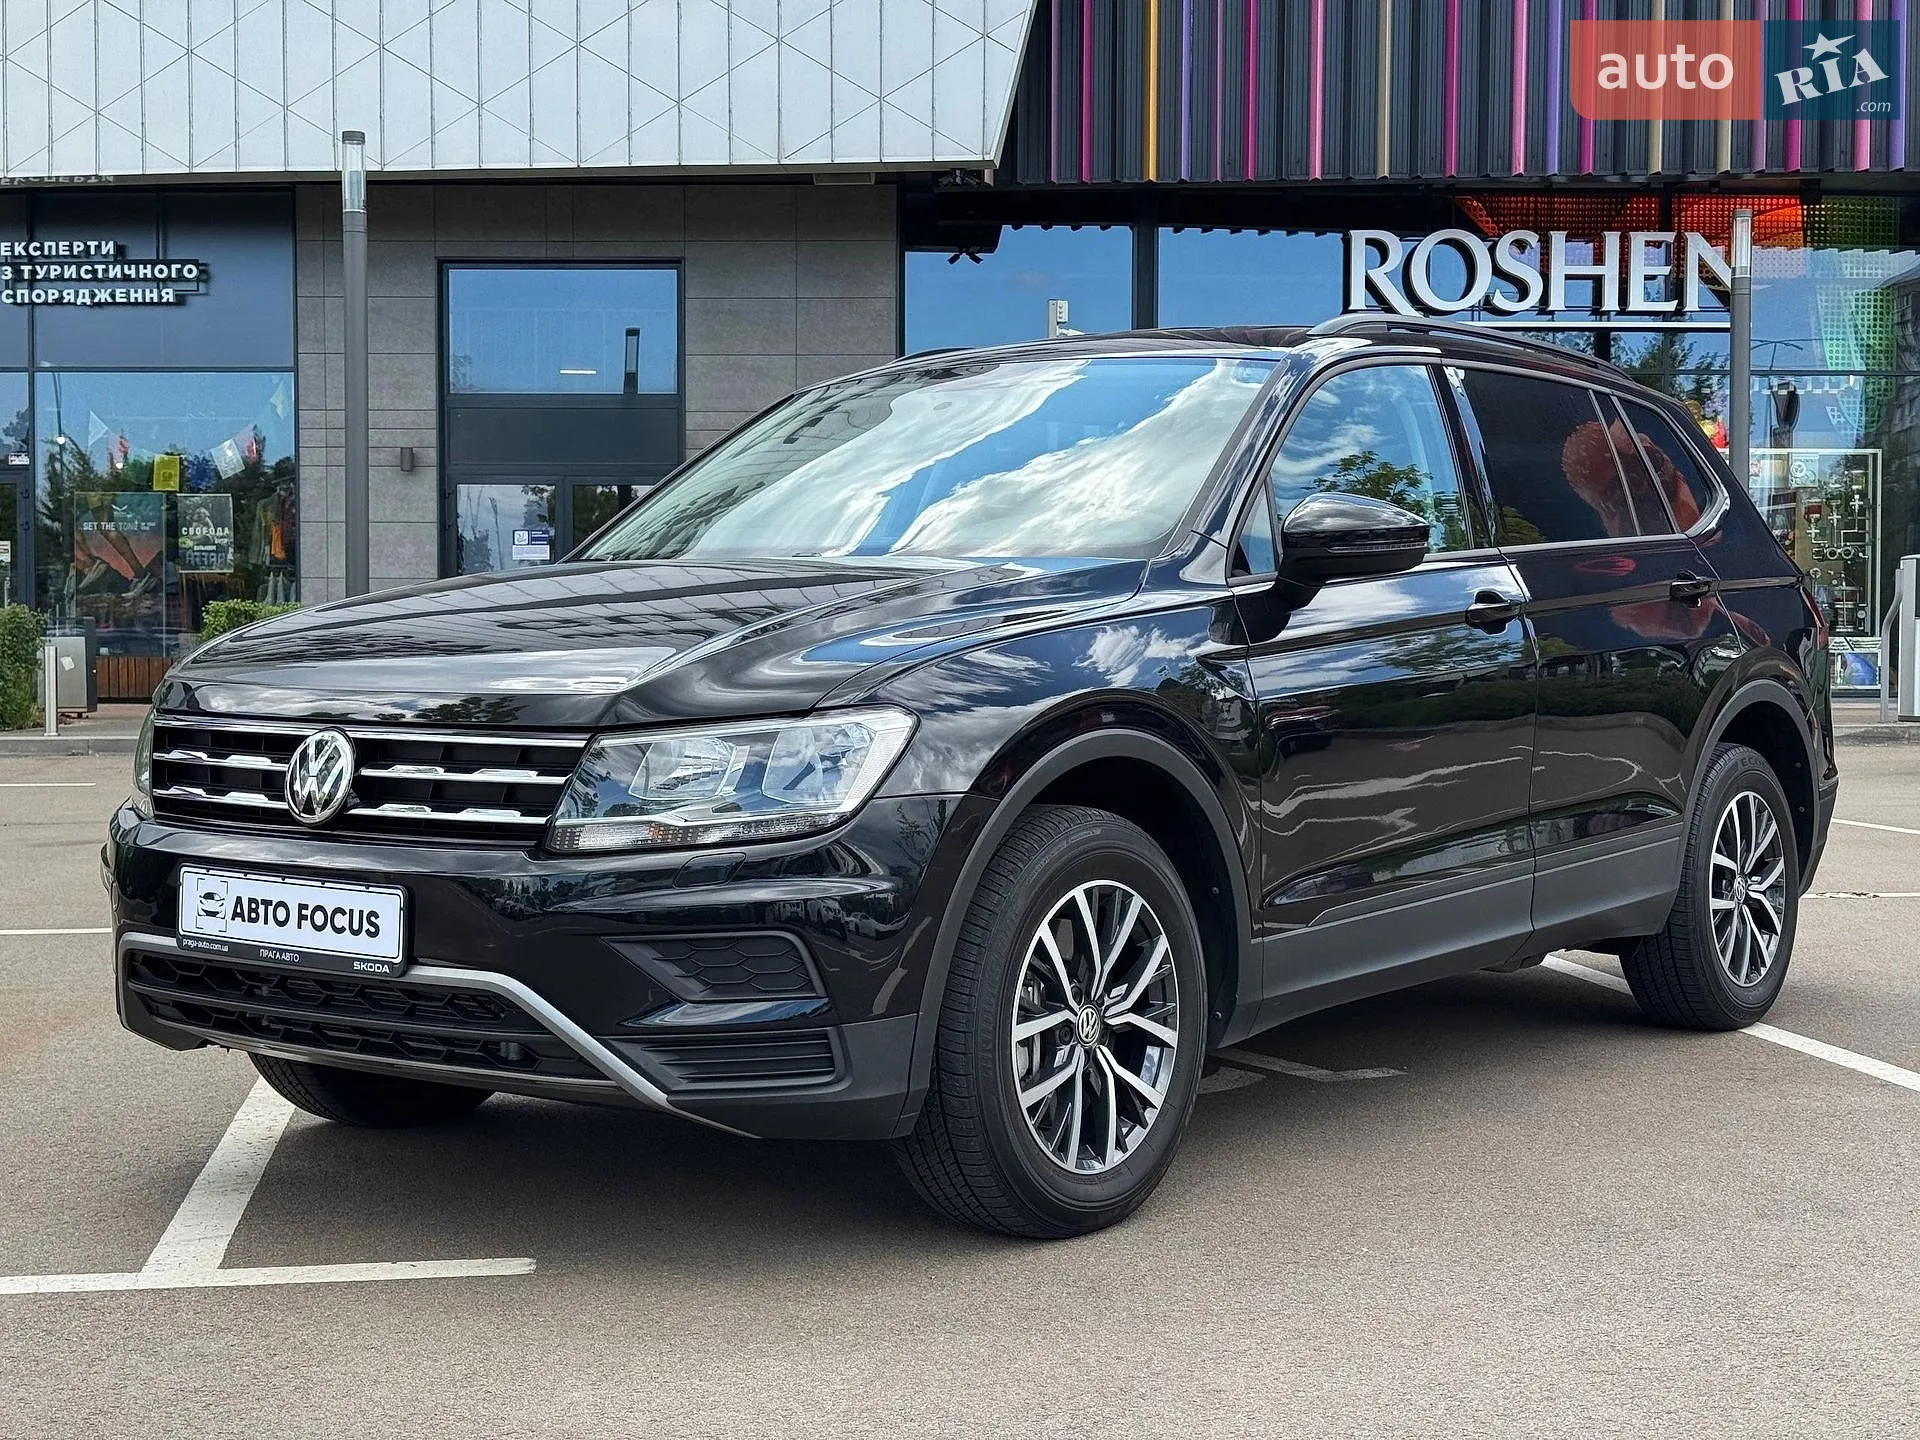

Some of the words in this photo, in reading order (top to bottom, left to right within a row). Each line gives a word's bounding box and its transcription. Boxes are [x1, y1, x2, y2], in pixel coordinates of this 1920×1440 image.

[0, 240, 116, 256] ЕКСПЕРТИ
[1, 266, 13, 280] З
[20, 263, 199, 280] ТУРИСТИЧНОГО
[1346, 228, 1733, 317] ROSHEN
[1, 287, 176, 306] СПОРЯДЖЕННЯ
[83, 521, 98, 531] SET
[101, 521, 117, 531] THE
[230, 895, 290, 928] АВТО
[296, 902, 381, 938] FOCUS
[259, 948, 281, 960] ПРАГА
[281, 951, 300, 962] АВТО
